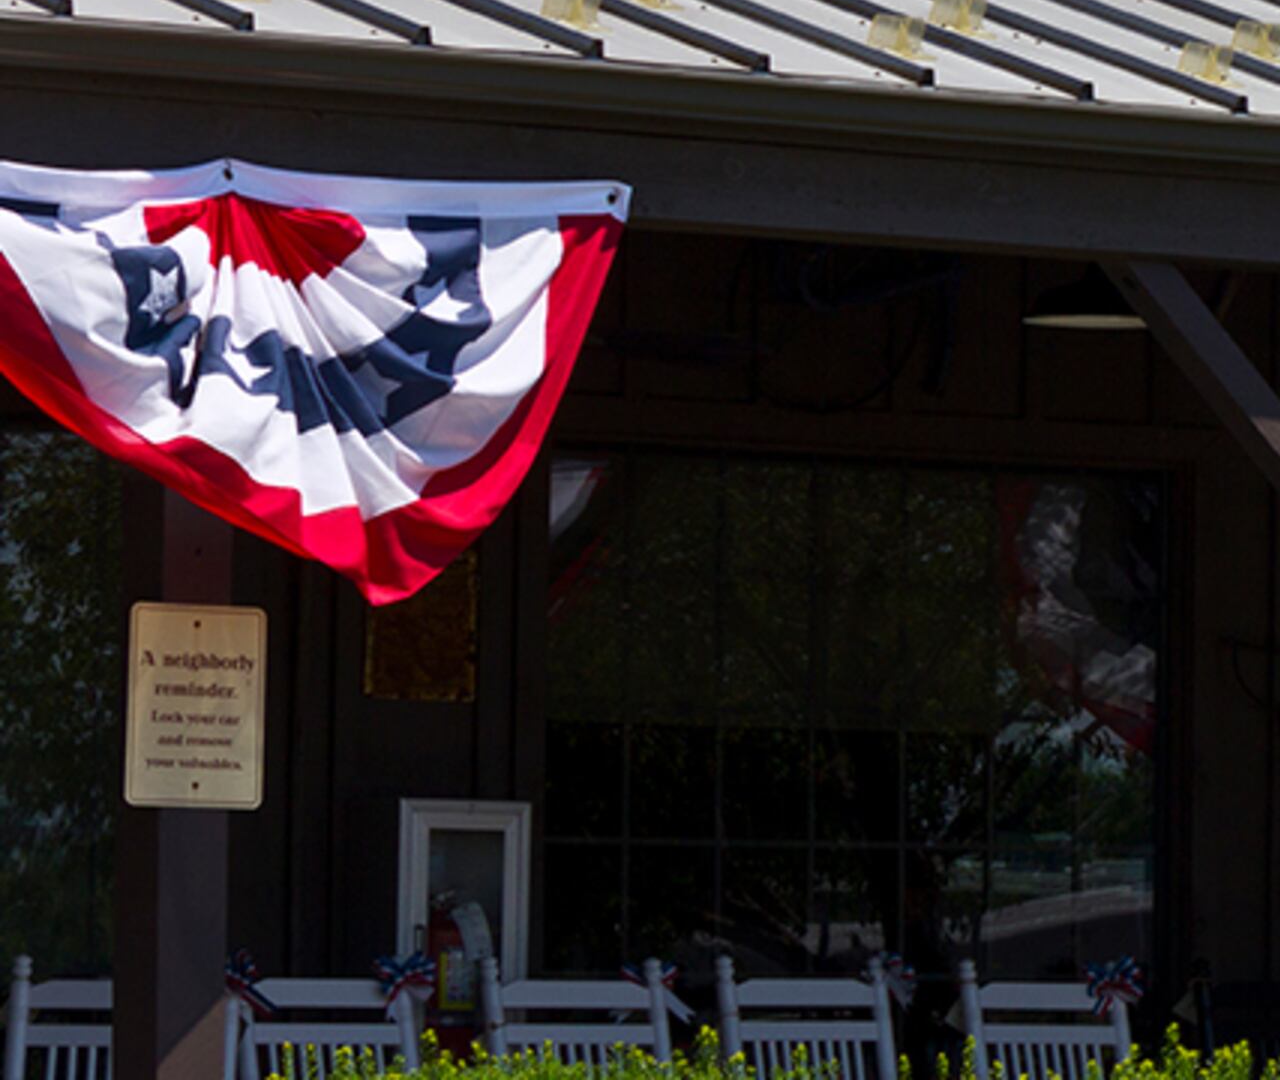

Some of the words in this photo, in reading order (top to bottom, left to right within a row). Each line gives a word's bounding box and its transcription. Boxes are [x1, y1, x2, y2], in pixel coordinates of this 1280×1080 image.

[141, 650, 155, 667] A
[163, 652, 254, 675] neighborly
[151, 709, 183, 724] Lock
[186, 713, 216, 727] your
[218, 715, 240, 726] car
[157, 734, 183, 746] and
[145, 758, 175, 771] your
